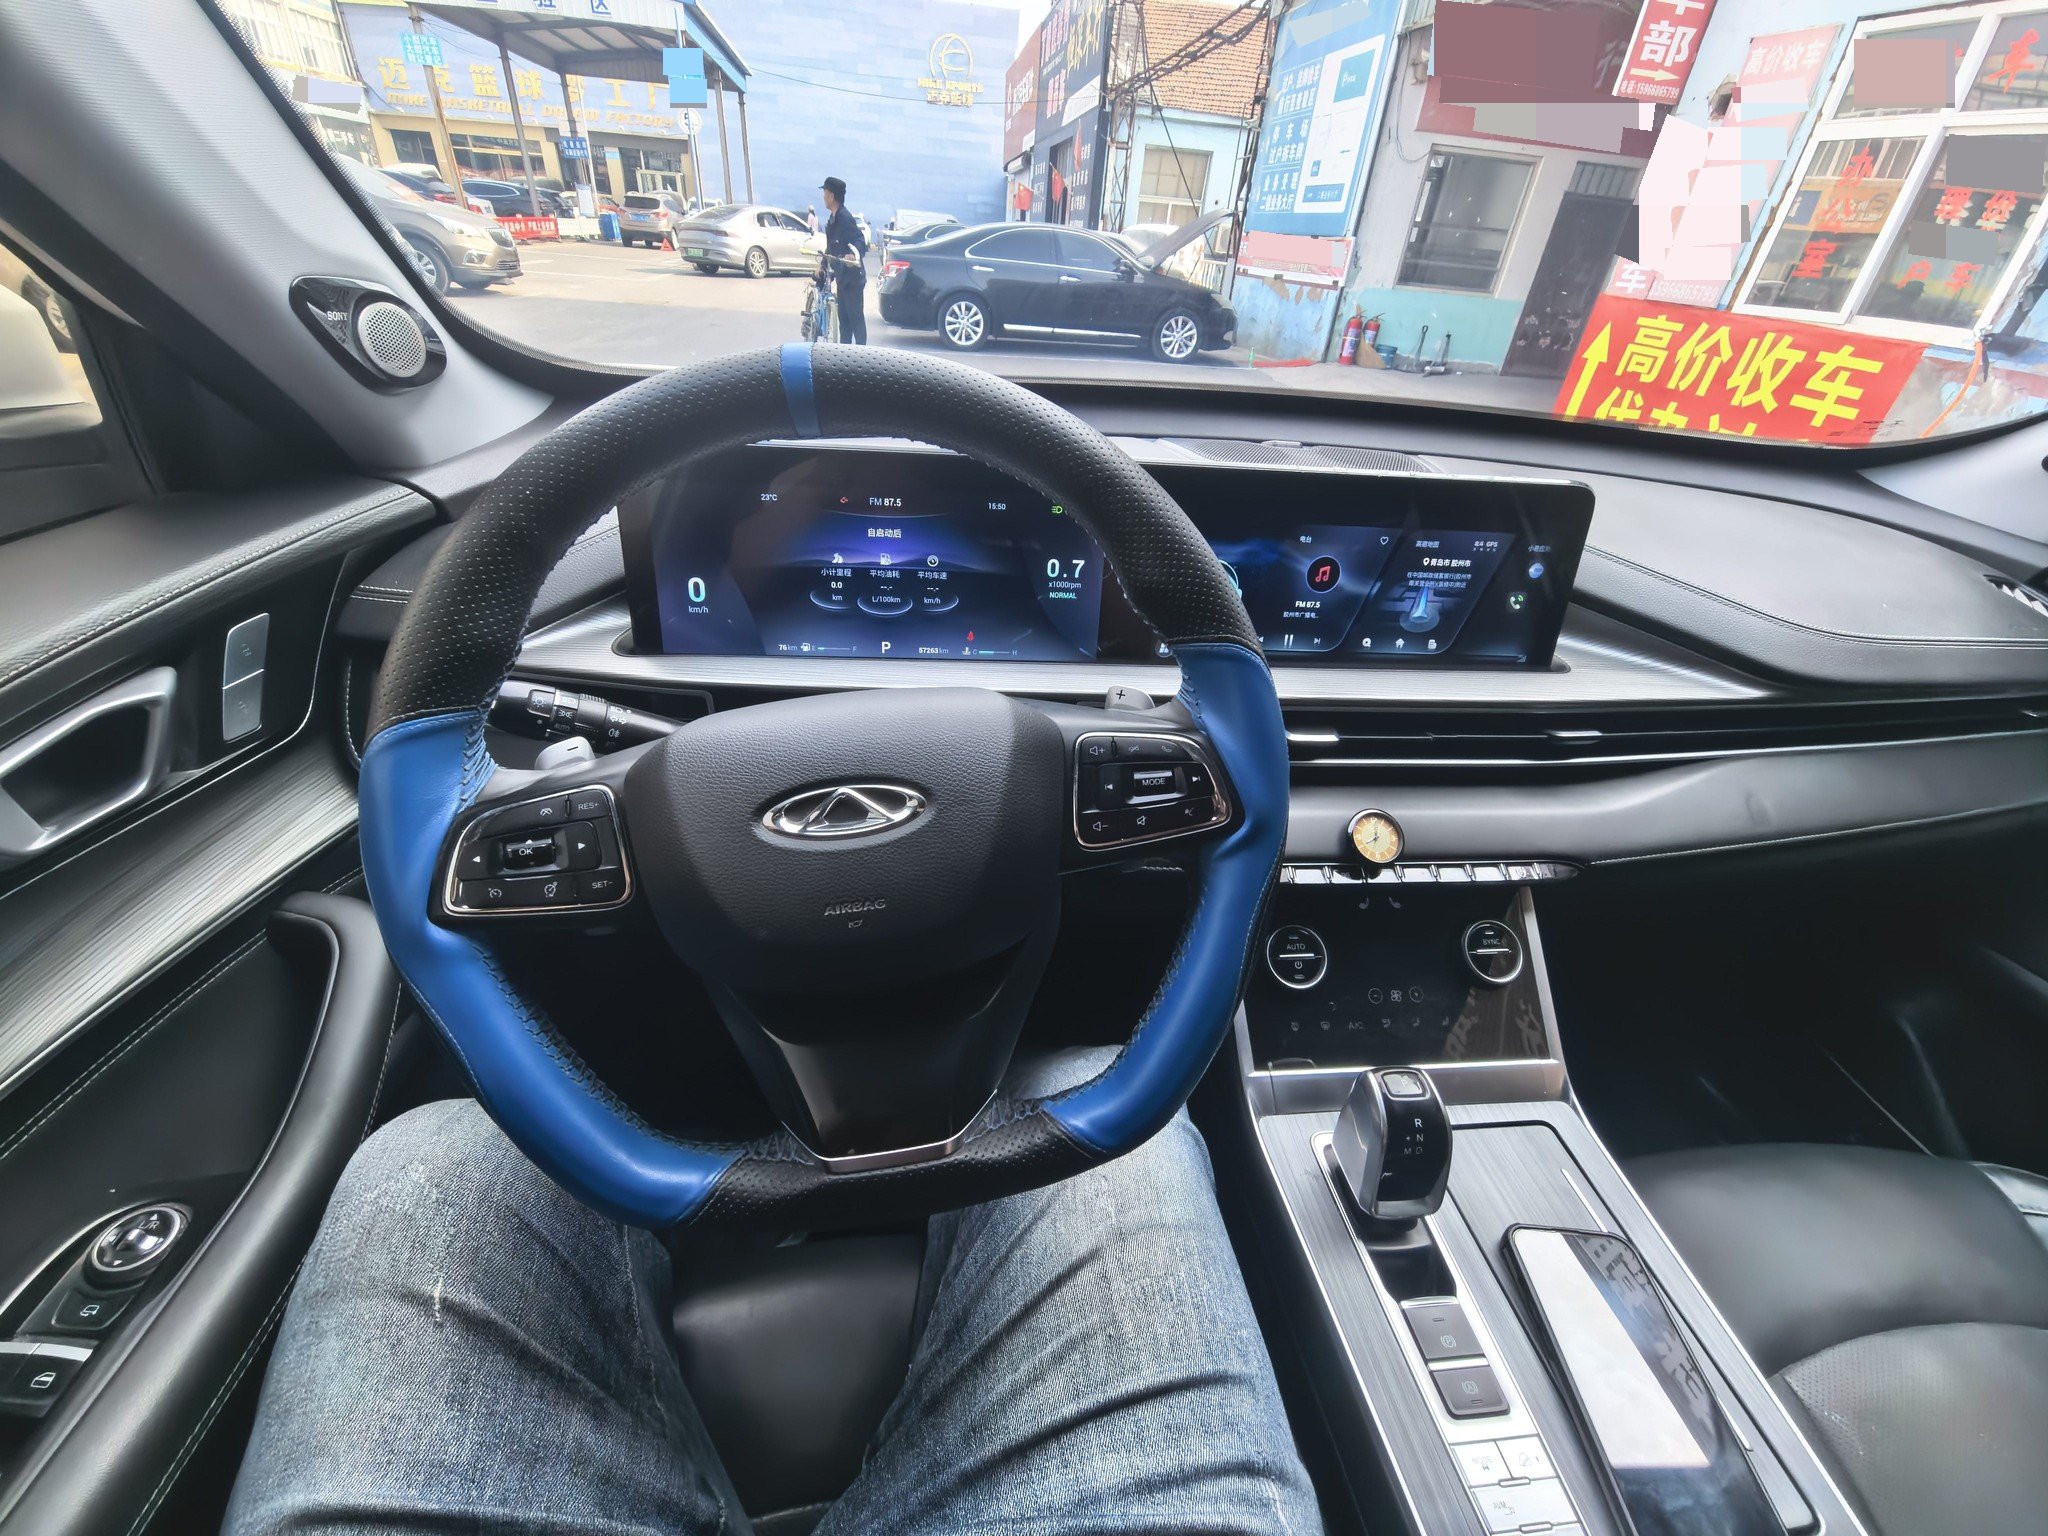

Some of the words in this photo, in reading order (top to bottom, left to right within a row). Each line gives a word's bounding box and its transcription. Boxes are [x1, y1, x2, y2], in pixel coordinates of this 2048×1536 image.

[1744, 39, 1827, 75] 高价收车
[327, 310, 348, 321] SONY
[1614, 314, 1885, 428] 高价收车
[869, 498, 882, 506] FM
[884, 498, 902, 507] 87.5
[988, 502, 1006, 510] 15:50
[867, 528, 902, 538] 自启动后
[1430, 558, 1450, 567] 青岛市
[1451, 559, 1472, 567] 胶州市
[820, 568, 852, 577] 小计里程
[1046, 558, 1086, 578] 0.7
[869, 570, 900, 578] 平均油耗
[917, 571, 948, 580] 平均车速
[830, 581, 843, 589] 0.0
[1048, 581, 1082, 589] x1000rpm
[687, 577, 706, 603] 0
[872, 595, 901, 603] L/100km
[1295, 600, 1306, 608] FM
[1306, 600, 1321, 609] 87.5
[881, 641, 891, 653] P
[1141, 776, 1166, 787] MODE
[578, 802, 599, 811] RES+
[518, 847, 533, 856] OK
[824, 898, 886, 917] AIRBAG
[1482, 938, 1501, 946] SYNC
[1414, 1118, 1423, 1128] R
[1416, 1134, 1424, 1142] N
[138, 1219, 159, 1231] L/R
